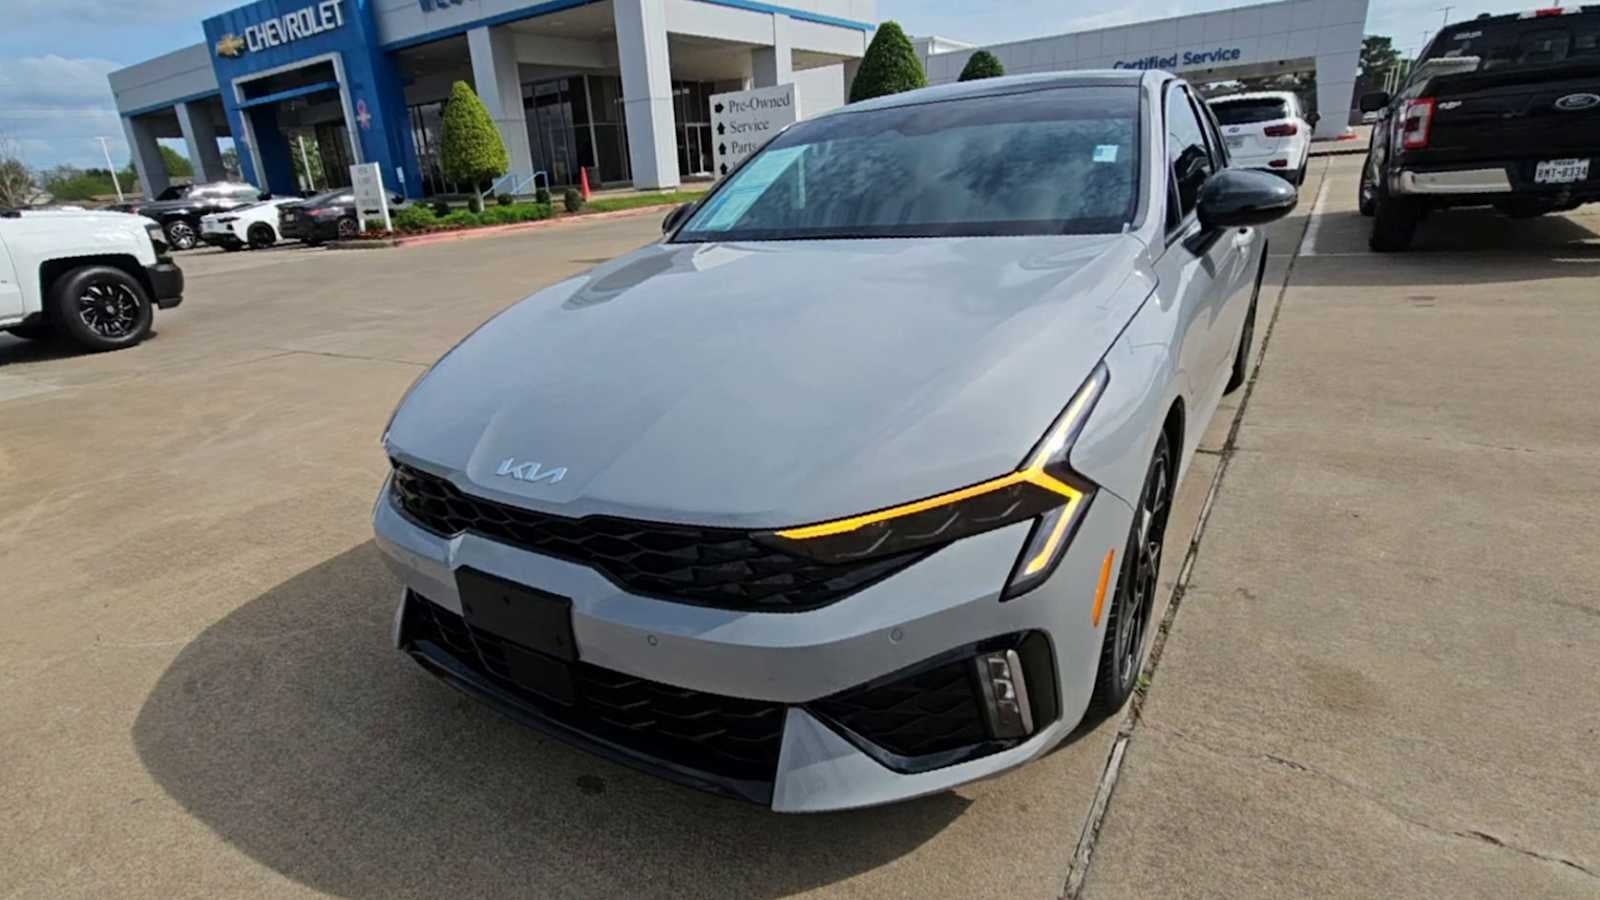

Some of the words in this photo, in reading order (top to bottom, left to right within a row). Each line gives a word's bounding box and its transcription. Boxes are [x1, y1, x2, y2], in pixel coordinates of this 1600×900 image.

[244, 0, 344, 52] CHEVROLET
[1182, 47, 1241, 65] Service
[729, 92, 790, 113] Pre-Owned
[730, 120, 769, 134] Service
[732, 141, 757, 154] Parts
[496, 457, 568, 484] KIA
